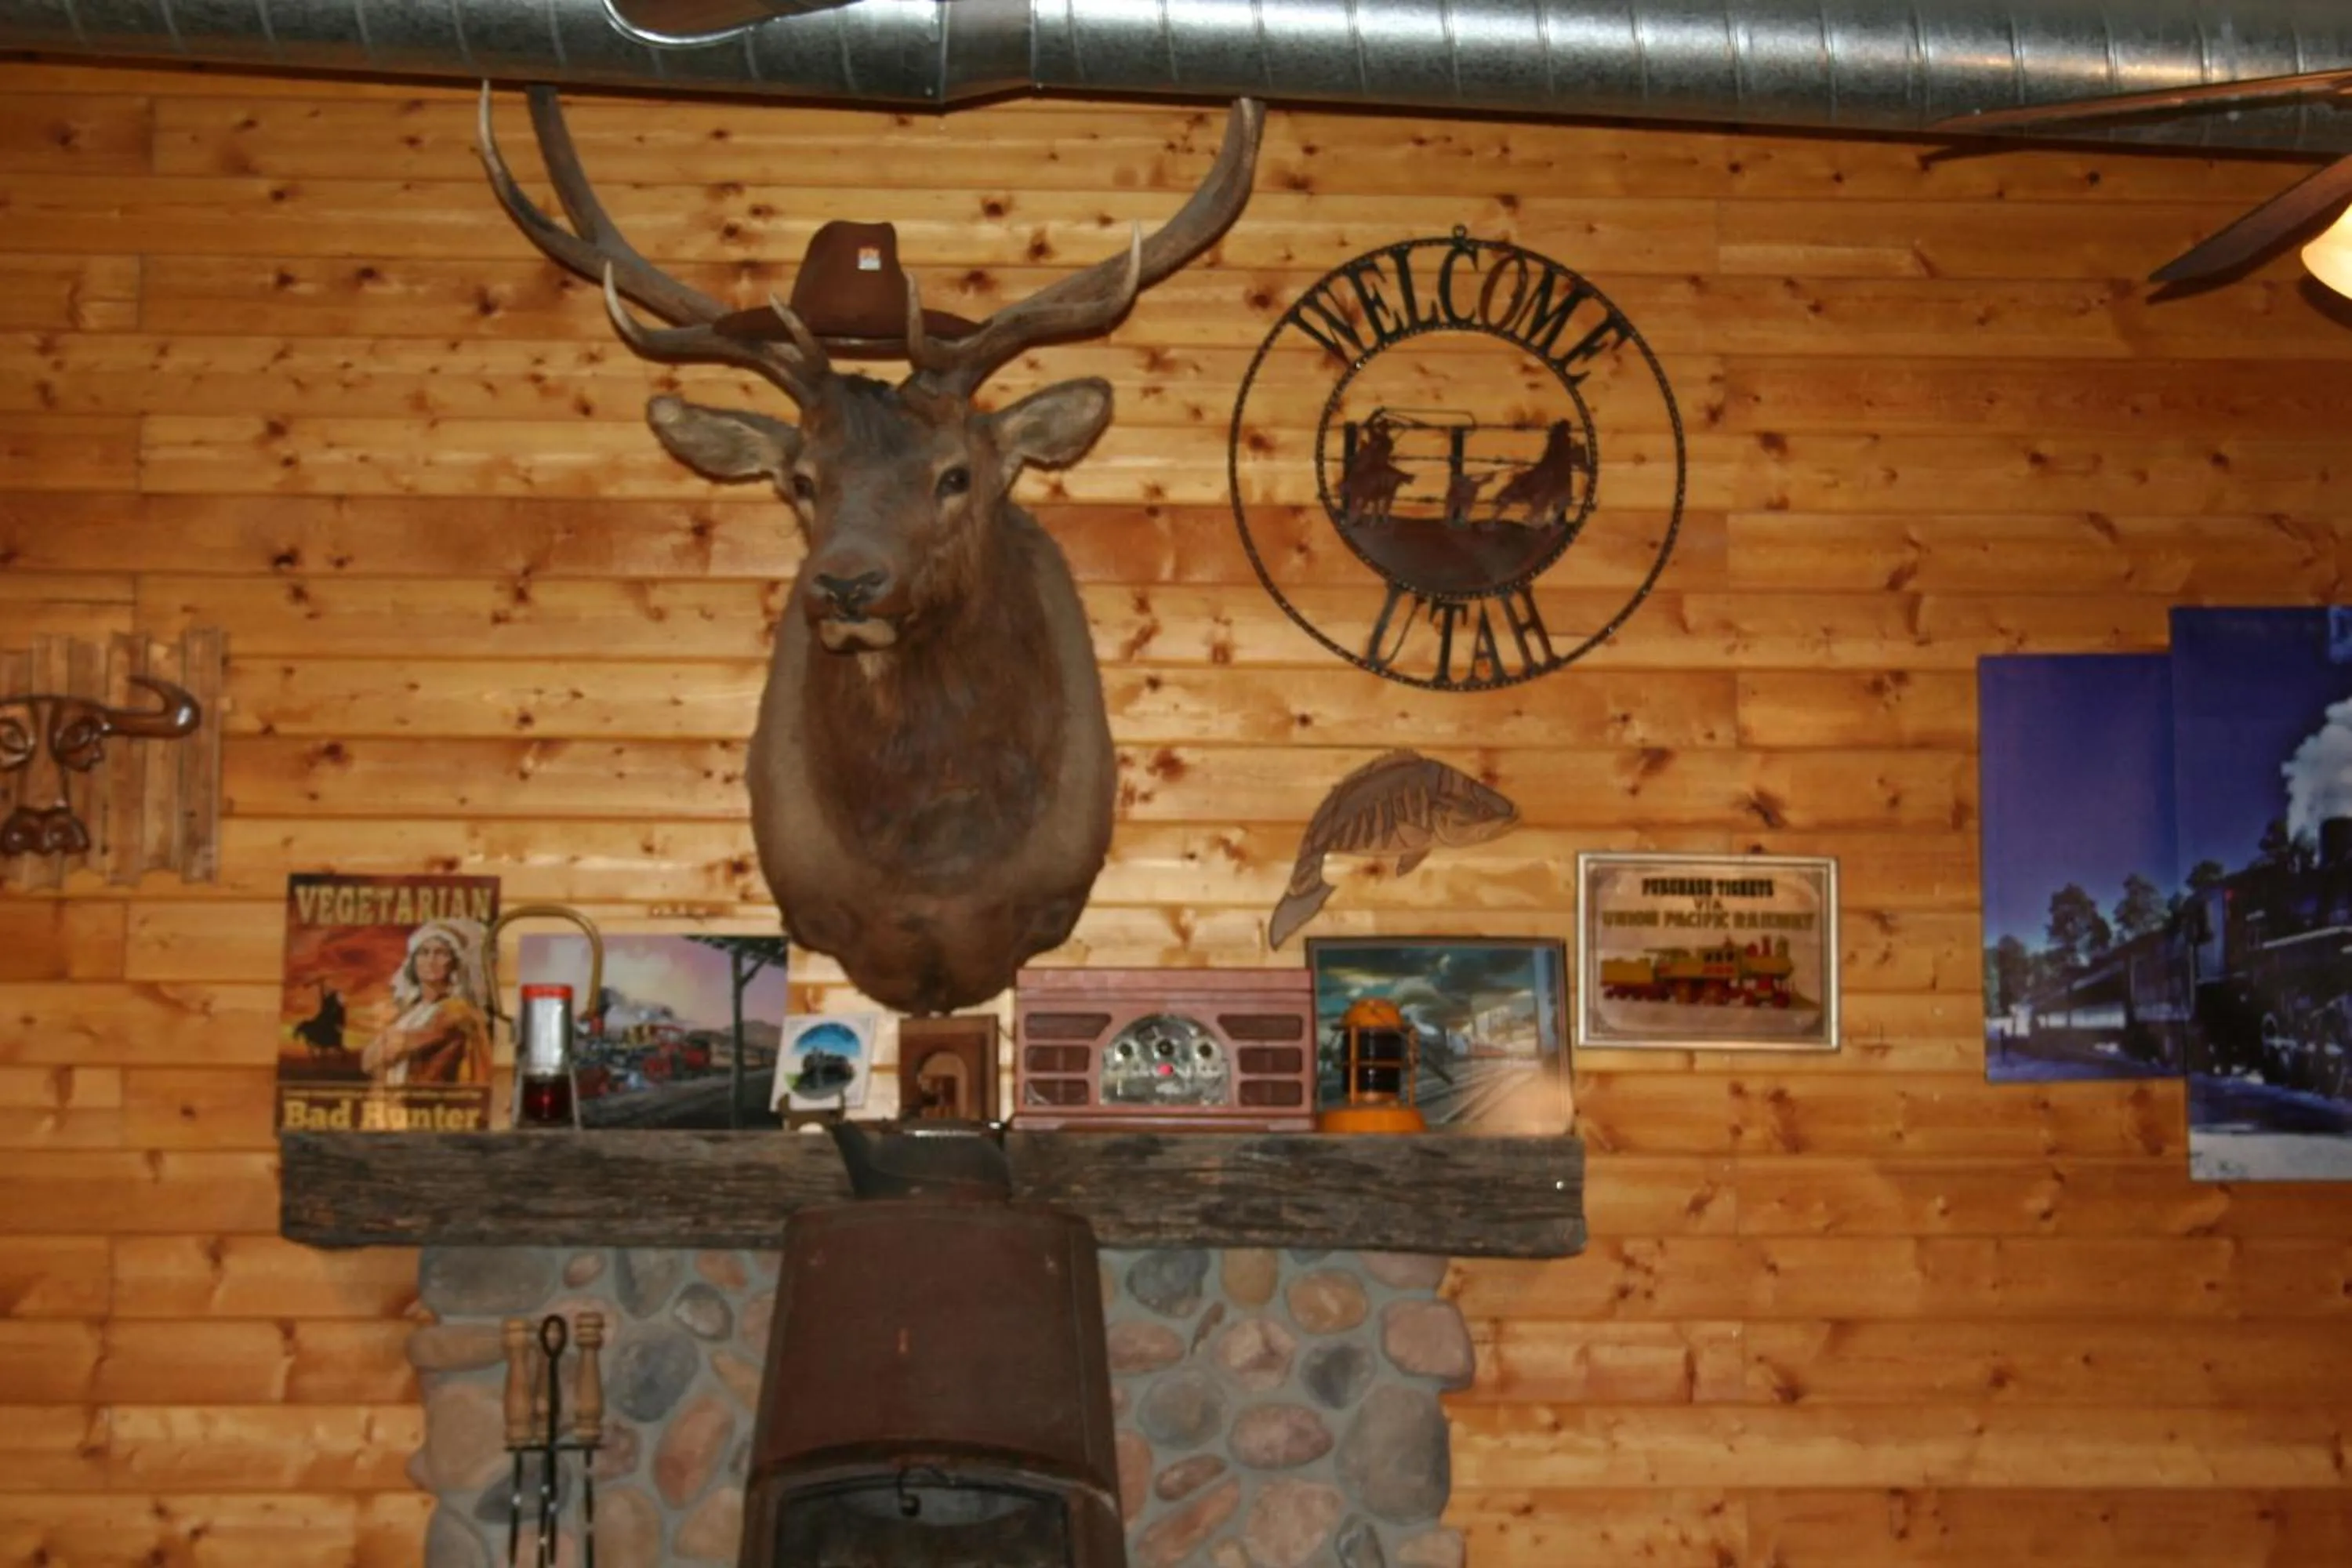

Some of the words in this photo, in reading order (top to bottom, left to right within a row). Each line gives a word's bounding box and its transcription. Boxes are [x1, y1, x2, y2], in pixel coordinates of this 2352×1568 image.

[1289, 245, 1635, 390] WELCOME
[1366, 582, 1563, 690] UTAH
[1642, 877, 1714, 897] PURCHASE
[1716, 878, 1774, 898] TICKETS
[295, 884, 493, 926] VEGETARIAN
[1664, 910, 1730, 929] PACIFIC
[1693, 898, 1723, 911] VIA
[283, 1099, 352, 1131] Bad
[359, 1098, 481, 1131] Hunter
